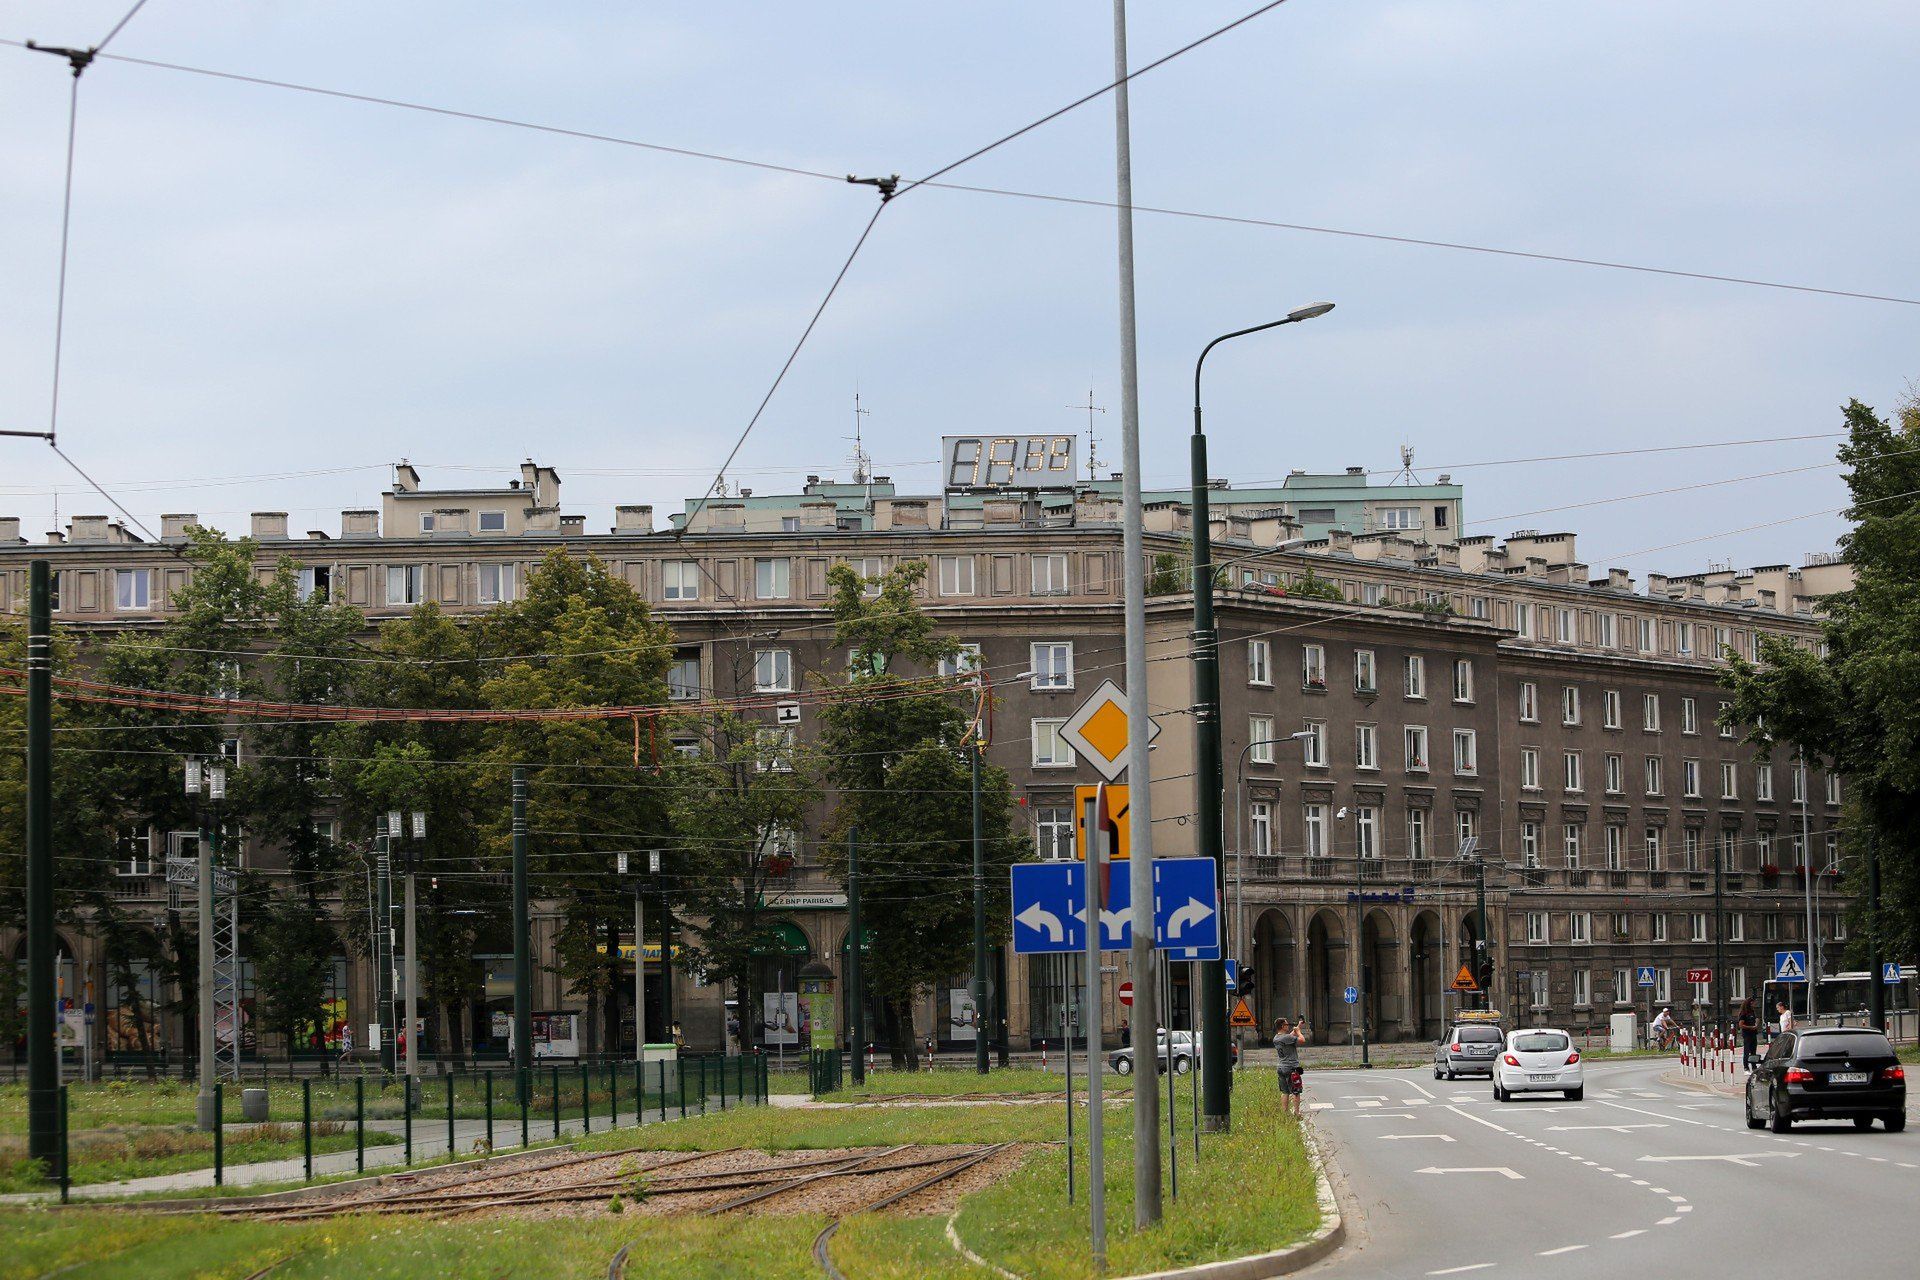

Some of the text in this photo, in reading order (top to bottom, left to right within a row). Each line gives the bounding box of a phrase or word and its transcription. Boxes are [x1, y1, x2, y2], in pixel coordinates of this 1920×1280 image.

[785, 897, 801, 905] BNP
[802, 897, 834, 905] PARIBAS
[1690, 972, 1700, 981] 79
